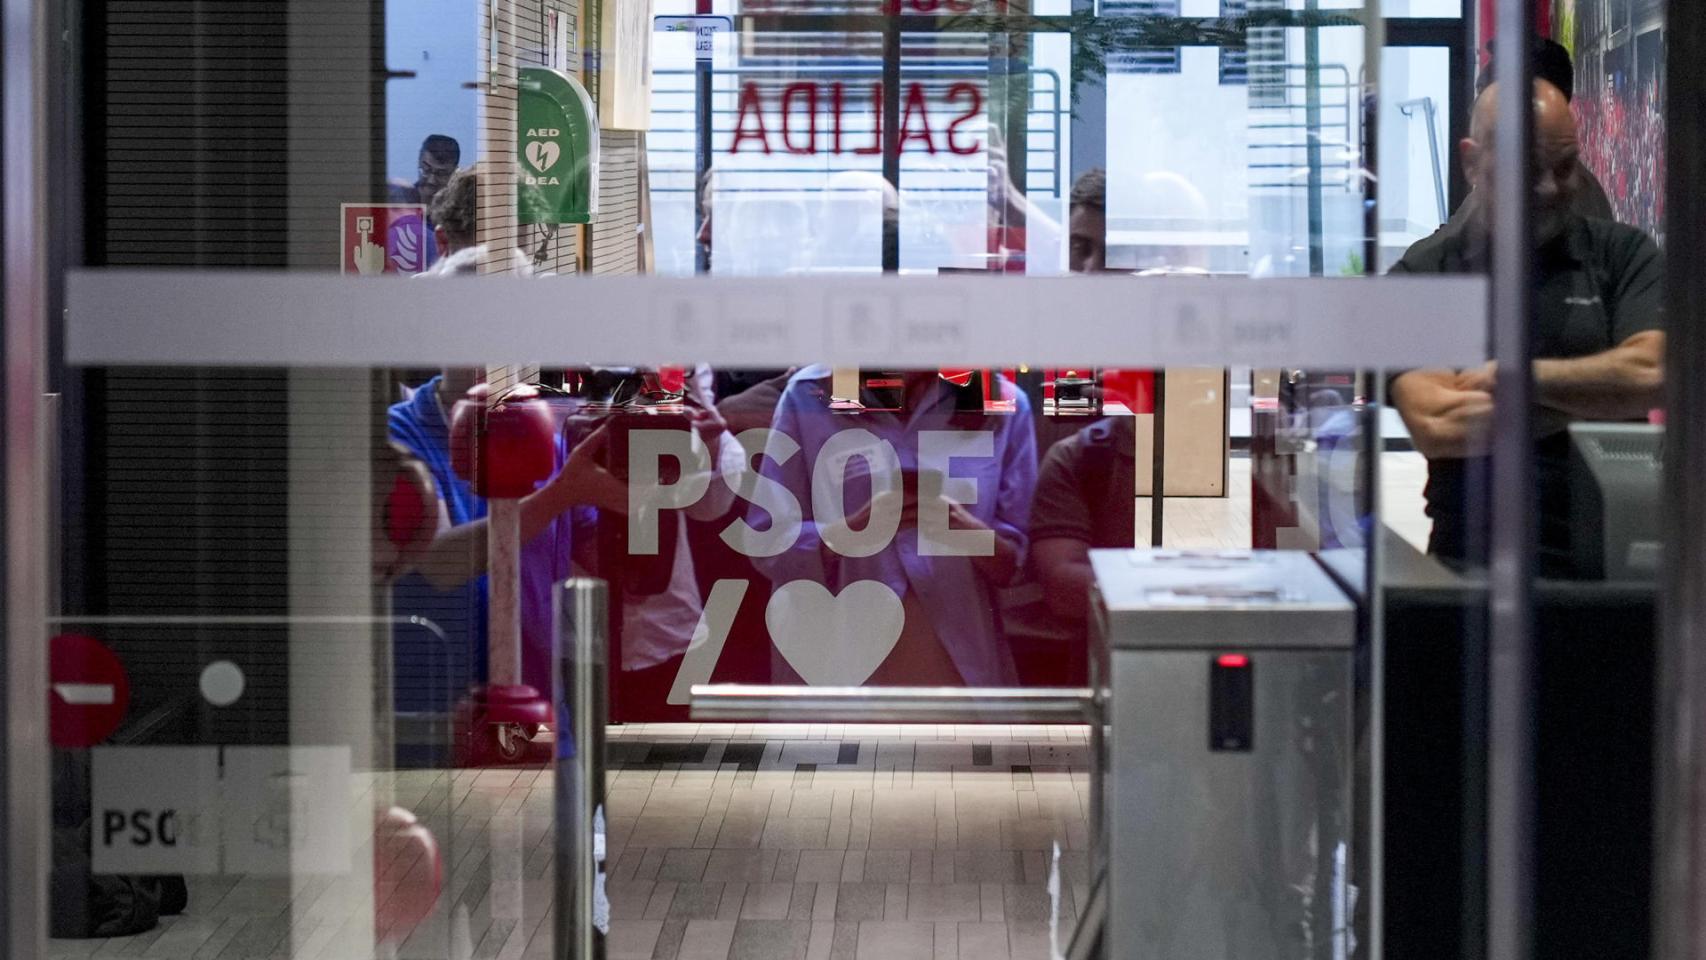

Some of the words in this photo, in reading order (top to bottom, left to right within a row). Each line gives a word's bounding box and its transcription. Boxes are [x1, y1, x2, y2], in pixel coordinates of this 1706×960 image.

[526, 128, 560, 137] AED
[525, 176, 560, 185] DEA
[628, 428, 995, 558] PSOE
[103, 808, 190, 846] PSO
